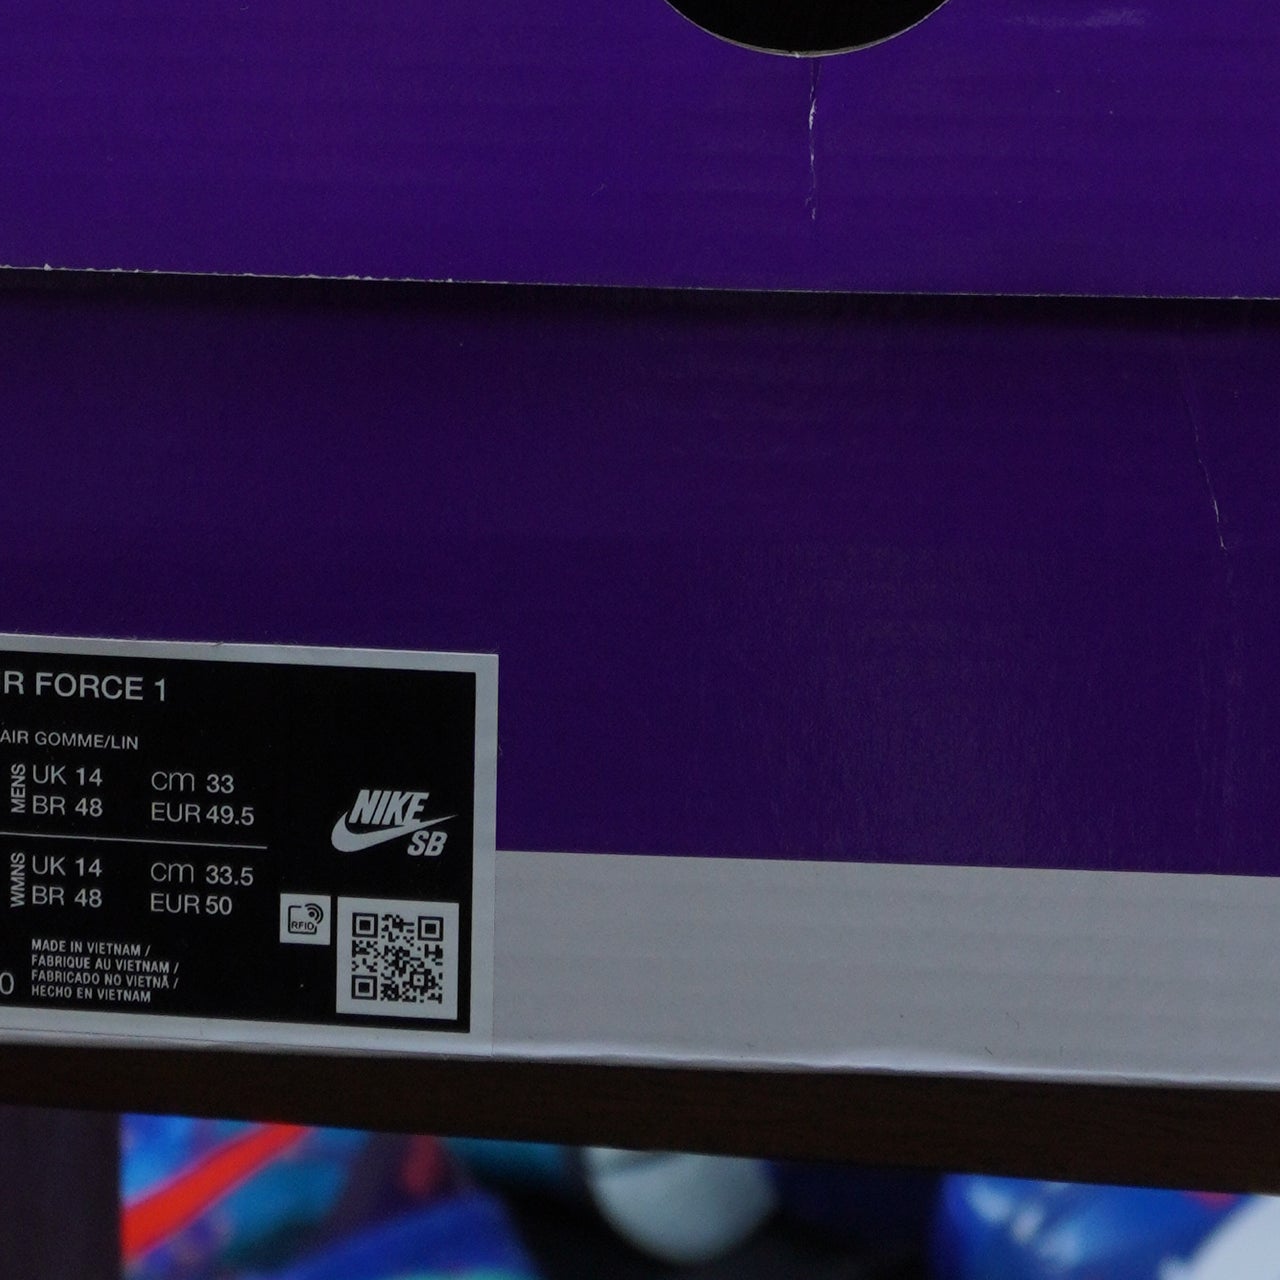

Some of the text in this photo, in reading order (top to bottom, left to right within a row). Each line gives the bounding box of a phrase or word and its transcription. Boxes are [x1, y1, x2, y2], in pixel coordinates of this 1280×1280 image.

[35, 672, 145, 701] FORCE
[154, 678, 166, 702] 1
[34, 732, 139, 750] GOMME/LIN
[32, 765, 103, 787] UK 14
[206, 773, 235, 793] 33
[11, 763, 26, 813] MENS
[32, 795, 104, 817] BR 48
[150, 802, 255, 826] EUR 49.5
[348, 789, 429, 826] NIKE
[406, 831, 448, 857] SB
[32, 855, 103, 878] UK 14
[205, 865, 254, 886] 33.5
[10, 852, 25, 908] WMNS
[32, 886, 103, 908] BR 48
[150, 893, 233, 916] EUR 50
[291, 921, 315, 931] RFID
[31, 938, 66, 952] MADE
[70, 941, 83, 953] IN
[86, 942, 141, 957] VIETNAM
[31, 954, 91, 970] FABRIQUE
[94, 958, 112, 971] AU
[115, 959, 170, 974] VIETNAM
[31, 969, 100, 985] FABRICADO
[104, 974, 122, 986] NO
[31, 985, 152, 1003] HECHO EN VIETNAM
